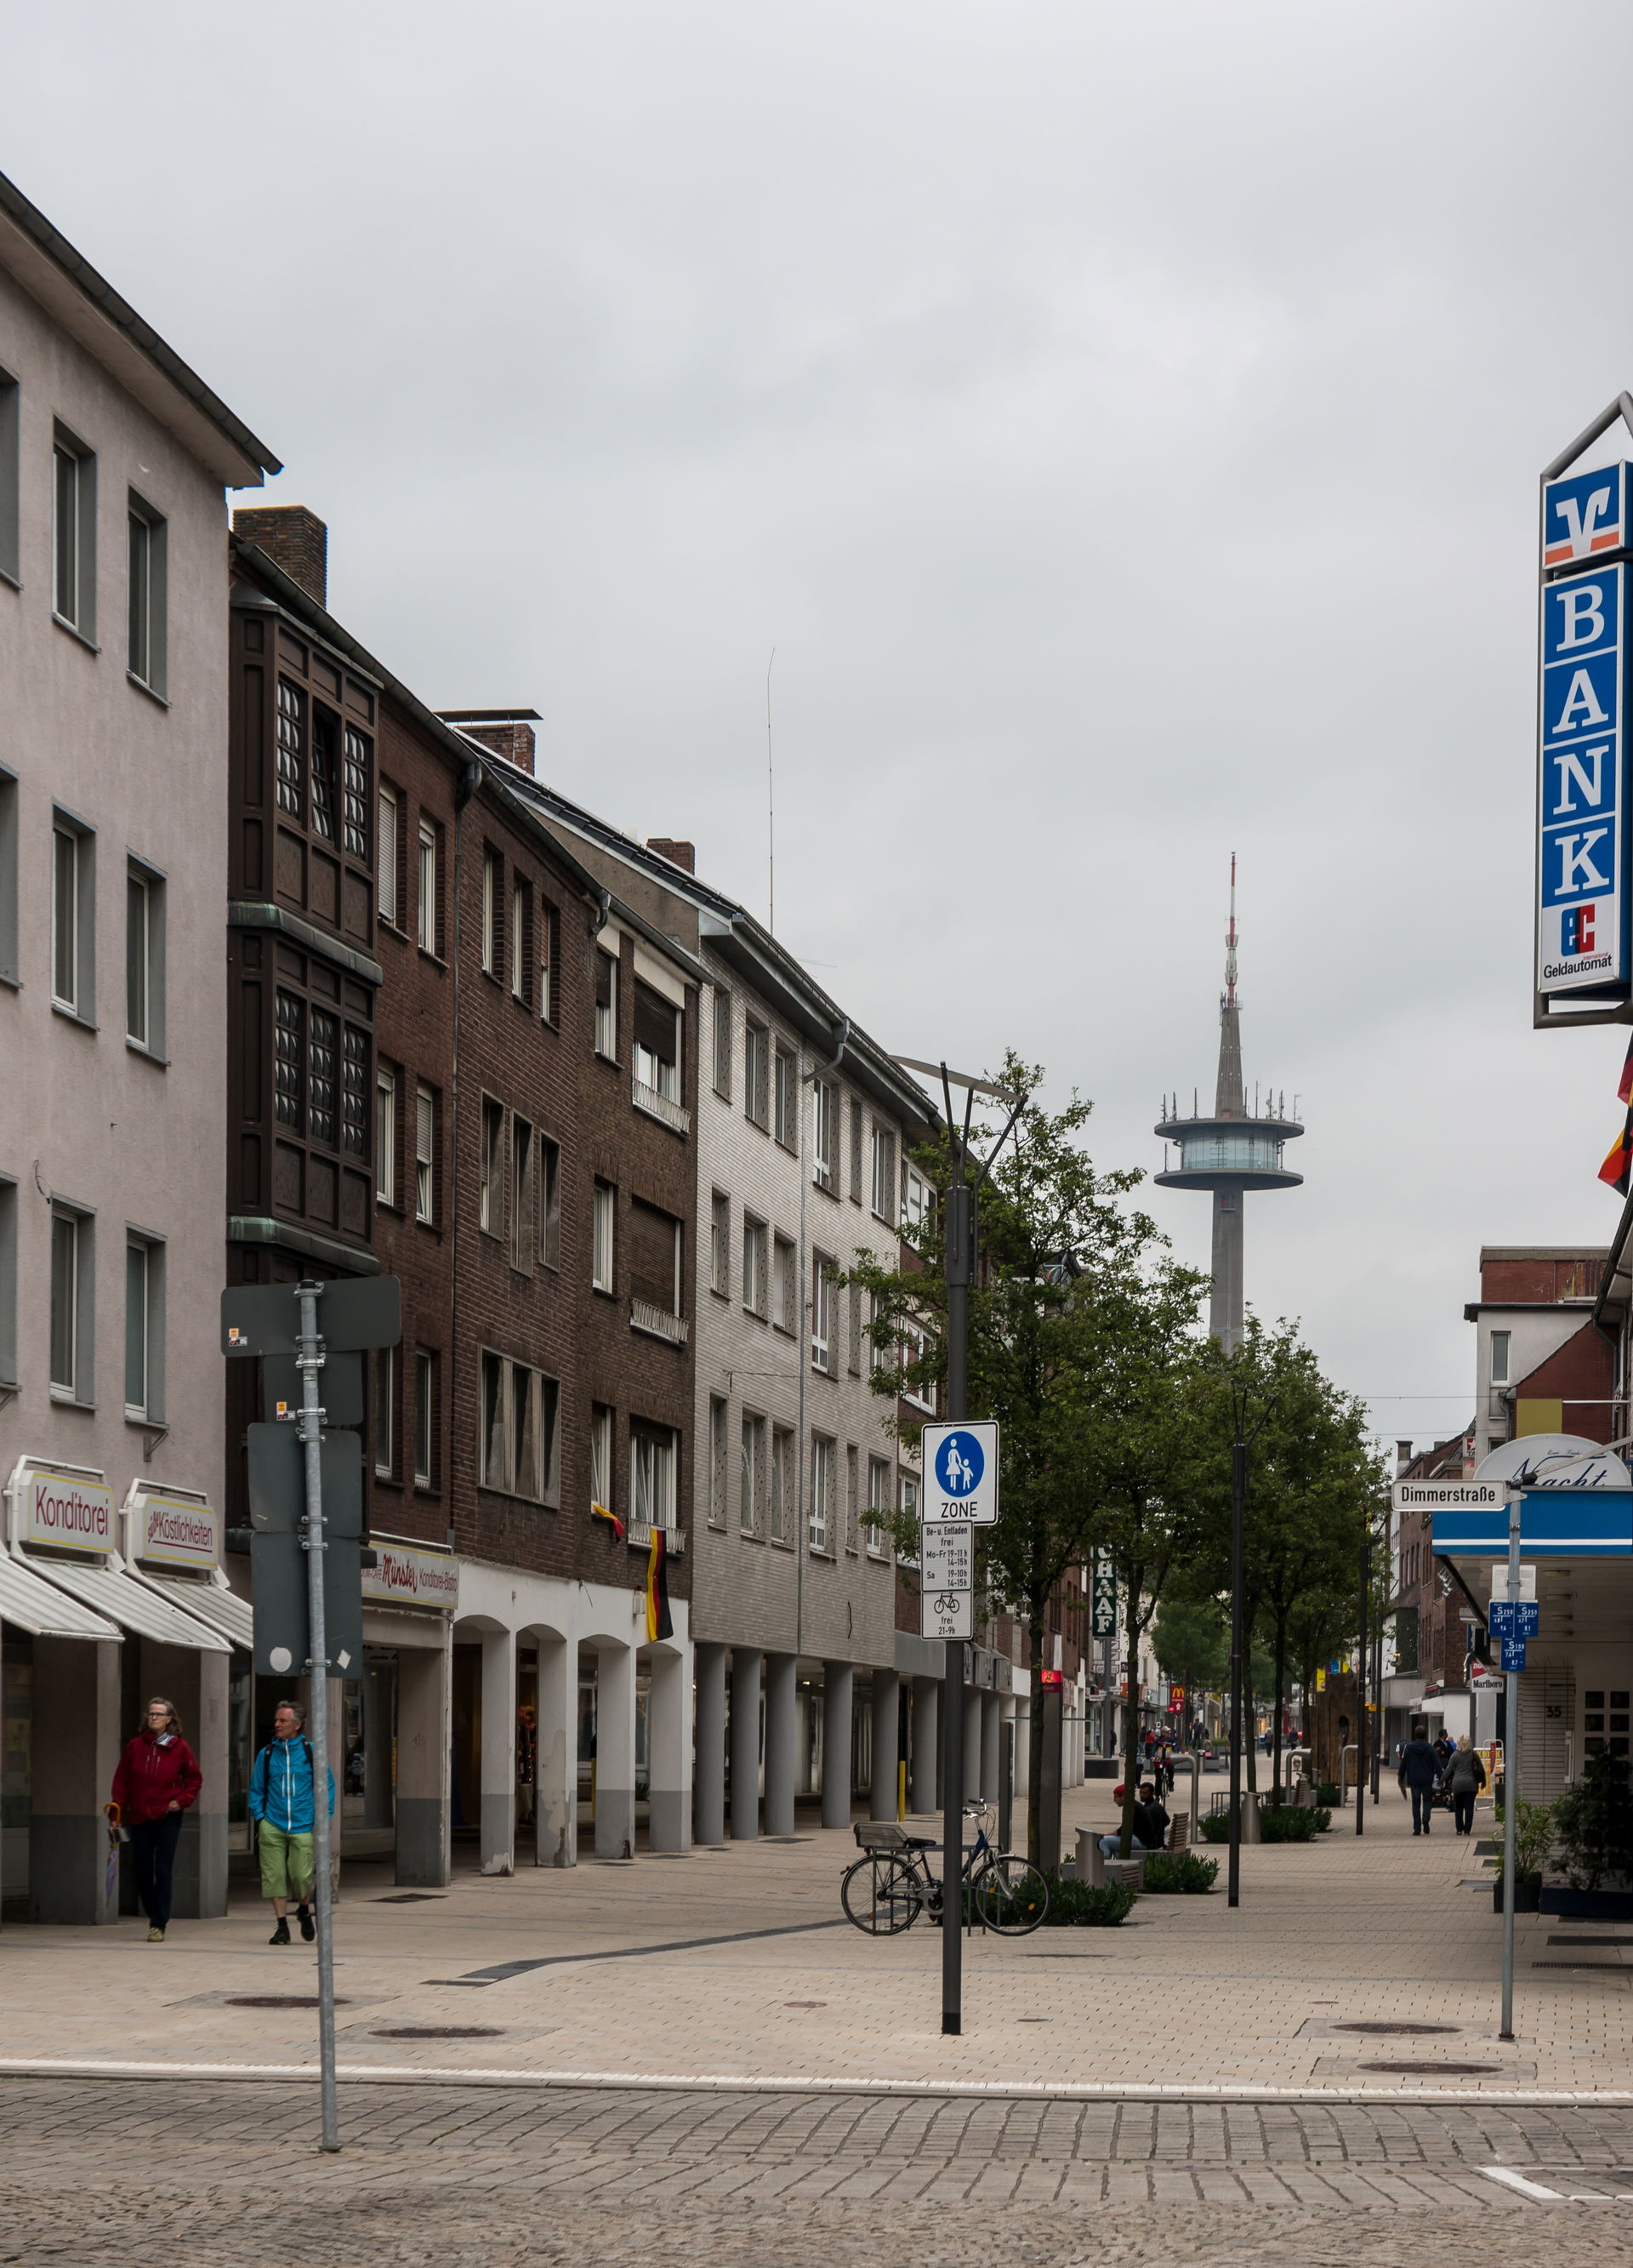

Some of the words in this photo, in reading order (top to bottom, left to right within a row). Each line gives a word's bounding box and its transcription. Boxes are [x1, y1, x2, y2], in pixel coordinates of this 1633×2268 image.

[1552, 584, 1610, 896] BANK
[1544, 954, 1612, 978] Geldautomat
[1401, 1485, 1495, 1502] Dimmerstraße
[36, 1484, 108, 1536] Konditorei
[941, 1502, 978, 1519] ZONE
[159, 1511, 213, 1547] Köstlichkeiten
[944, 1525, 968, 1536] Entladen
[941, 1537, 953, 1547] frei
[927, 1550, 947, 1559] Mo-Fr
[382, 1553, 418, 1593] Münster
[942, 1616, 953, 1625] frei
[1473, 1679, 1503, 1689] Marlboro
[1546, 1705, 1562, 1718] 35
